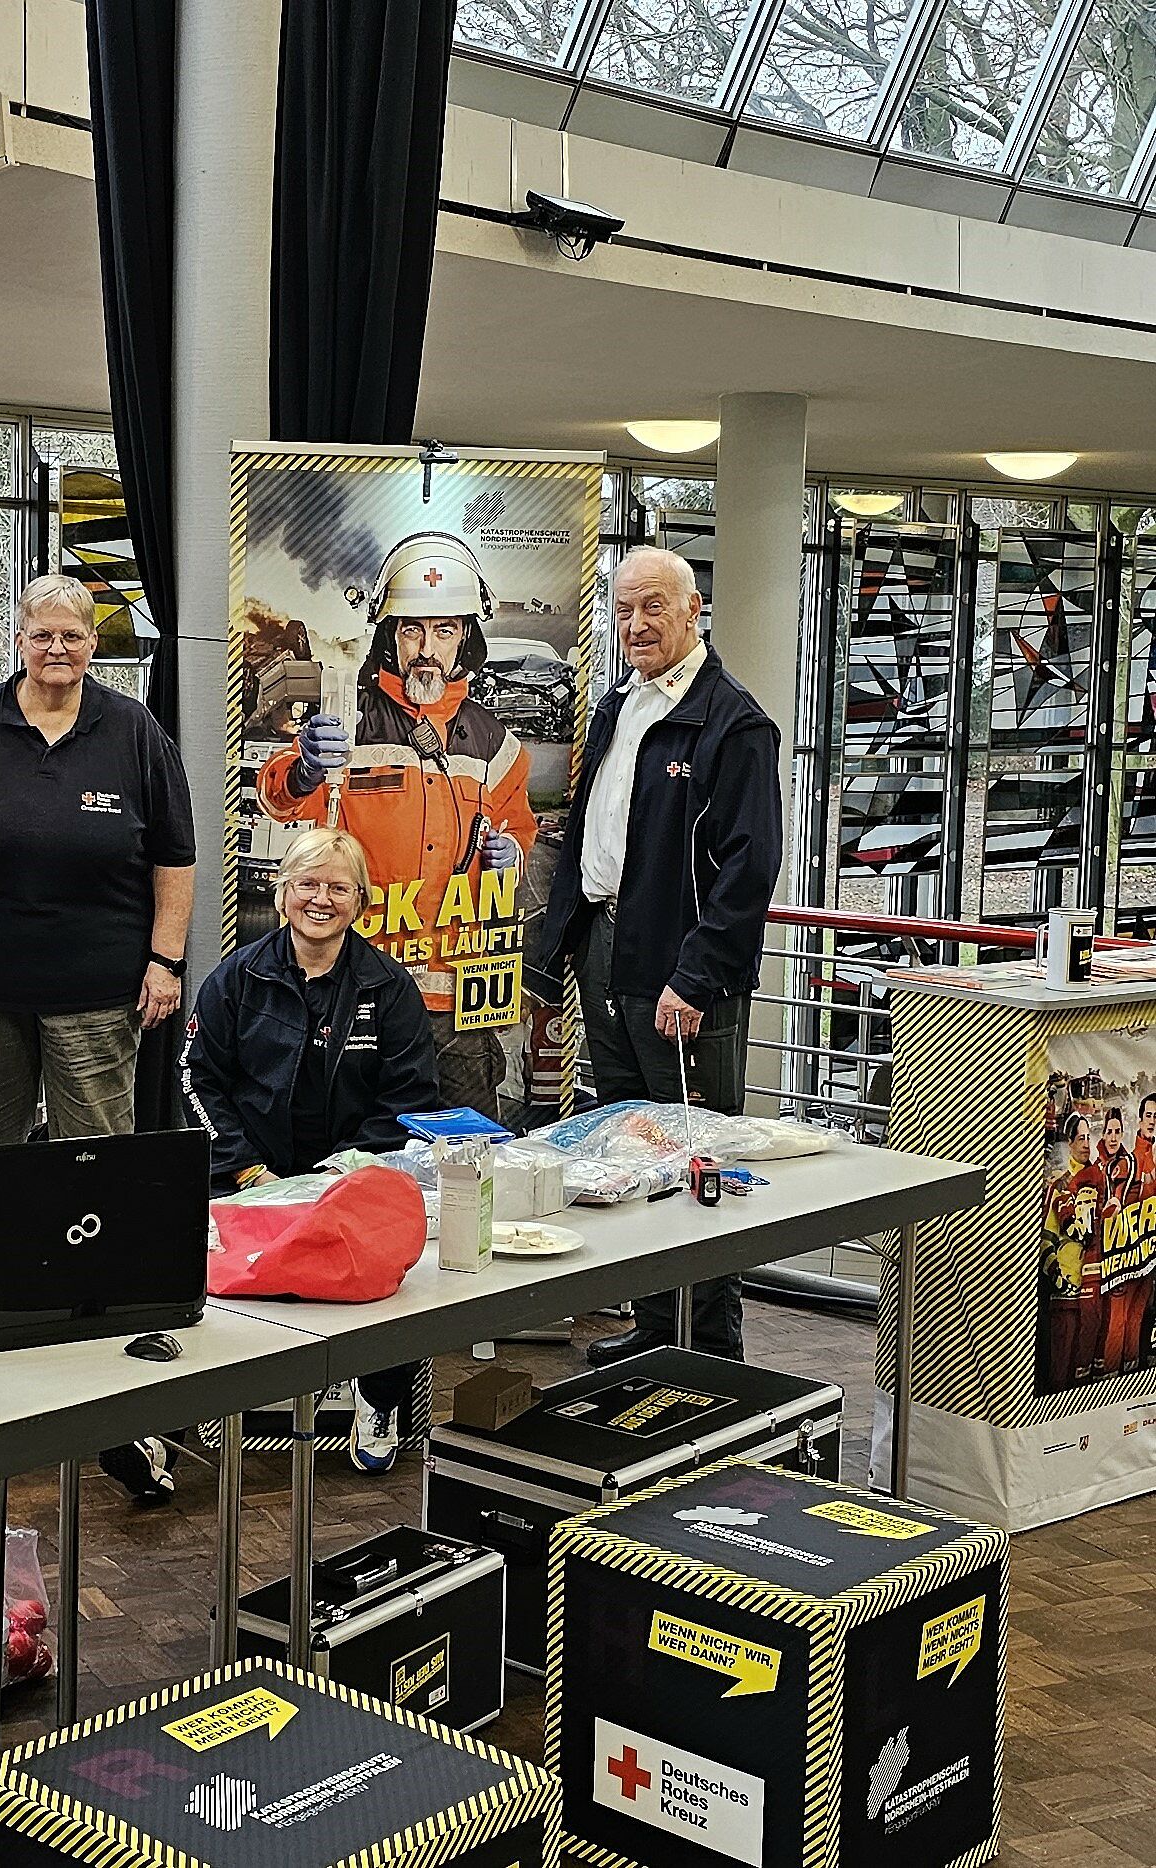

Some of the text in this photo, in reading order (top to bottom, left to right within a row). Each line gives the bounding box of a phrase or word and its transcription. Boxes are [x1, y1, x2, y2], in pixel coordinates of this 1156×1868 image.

[480, 528, 571, 538] KATASTROPHENSCHUTZ
[480, 535, 570, 545] NORDRHEIN-WESTFALEN
[351, 866, 525, 939] CK AN,
[377, 924, 525, 963] LES LÄUFT!
[463, 959, 516, 975] WENN NICHT
[461, 972, 515, 1013] DU,
[460, 1014, 481, 1026] WER
[1101, 1246, 1140, 1279] WENN
[924, 1619, 980, 1655] WENN NICHTS
[926, 1604, 979, 1640] WER KOMMT,
[659, 1619, 774, 1669] WENN NICHT WIR,
[659, 1633, 736, 1668] WER DANN?
[922, 1634, 975, 1671] MEHR GEHT?
[173, 1694, 264, 1732] WER KOMMT,
[183, 1698, 276, 1739] WENN NICHTS
[194, 1706, 281, 1745] MEHR GEHT?
[249, 1752, 391, 1820] KATASTROPHENSCHUTZ
[260, 1757, 403, 1825] NORDRHEIN-WESTFALEN
[660, 1759, 749, 1807] Deutsches
[660, 1778, 709, 1811] Rotes
[885, 1755, 970, 1811] KATASTROPHENSCHUTZ
[885, 1767, 970, 1824] NORDRHEIN-WESTFALEN
[660, 1797, 709, 1830] Kreuz
